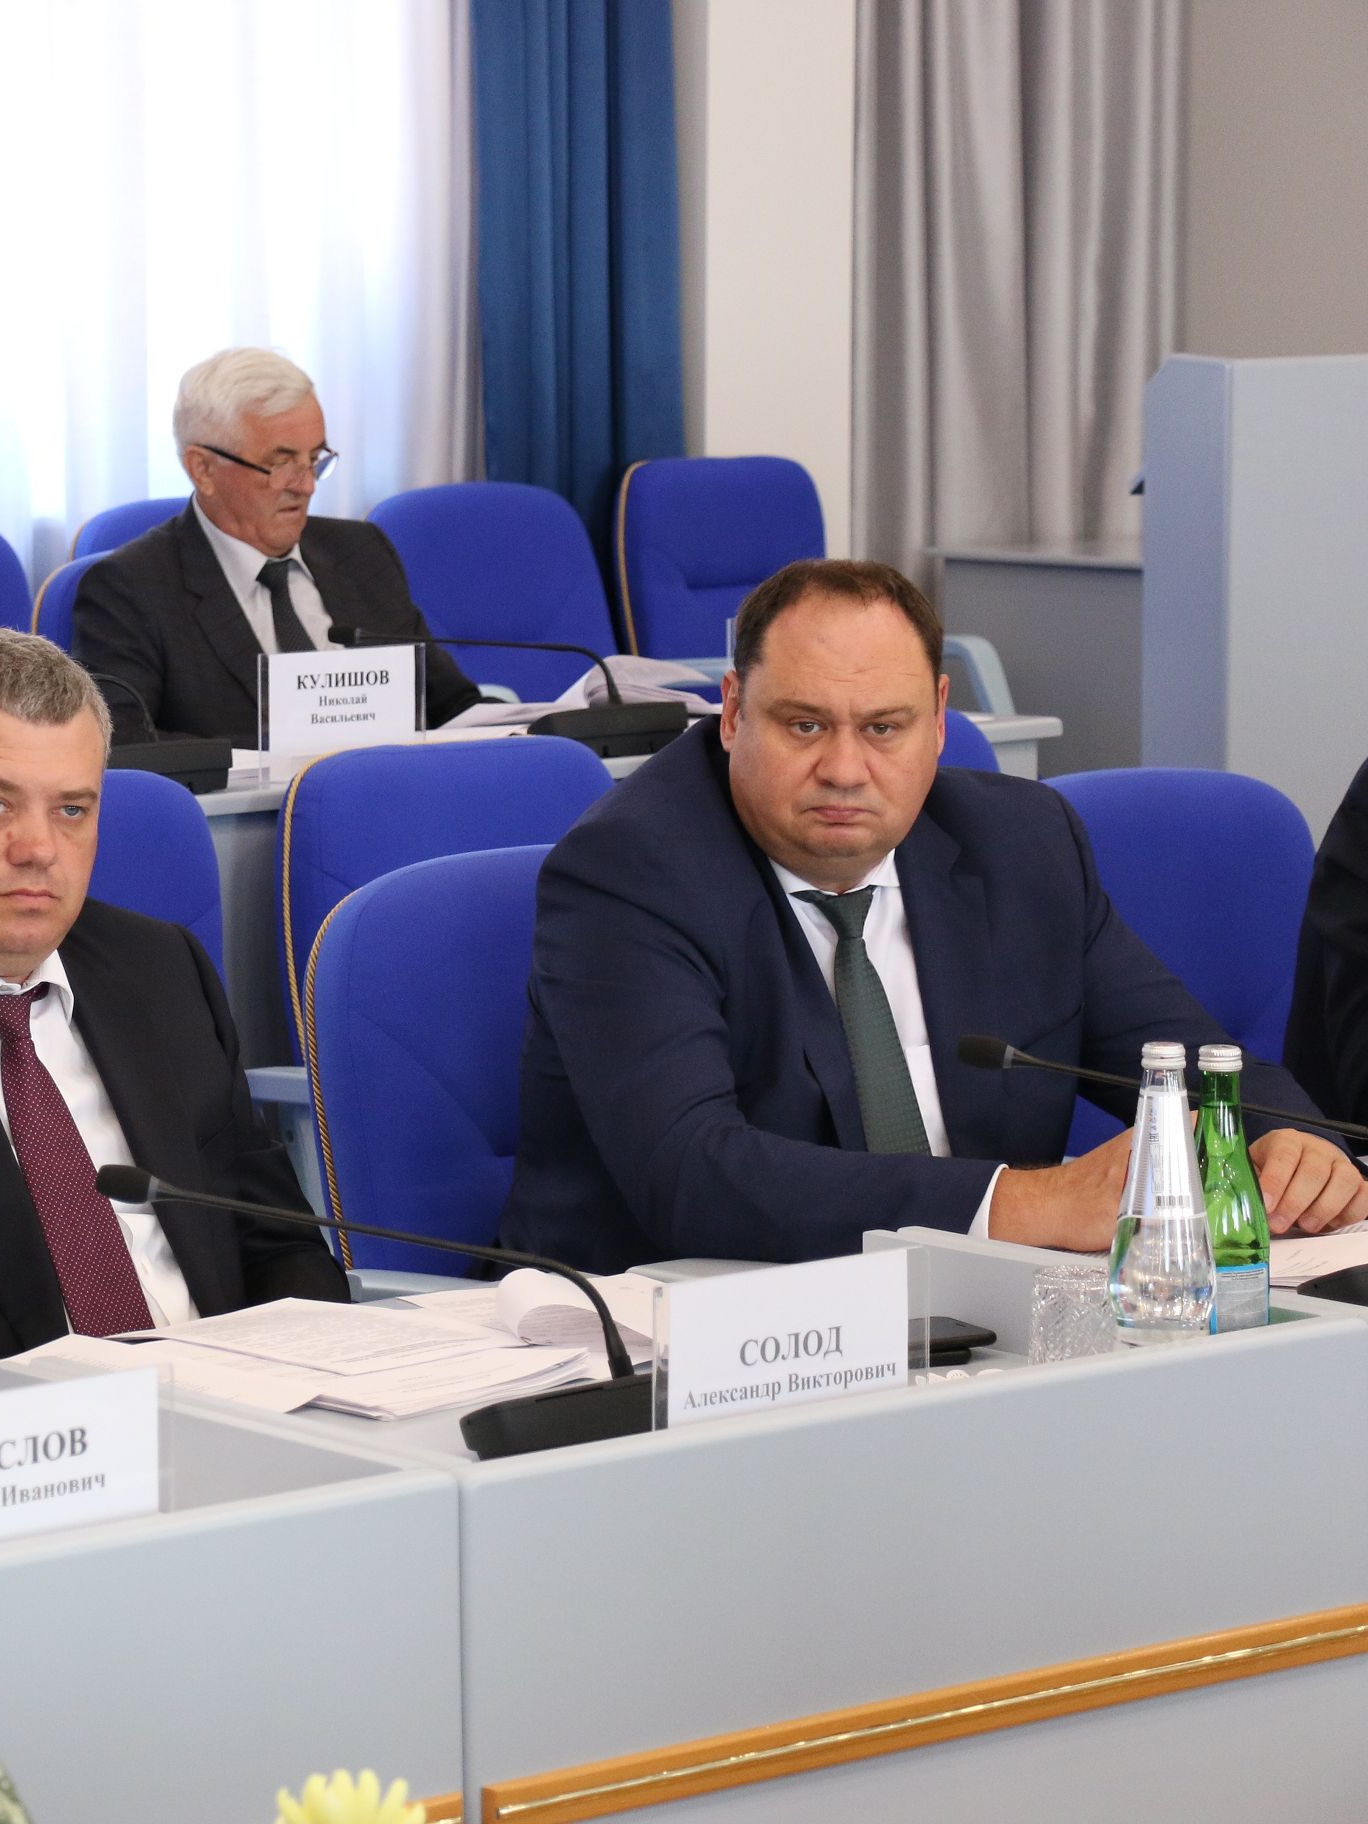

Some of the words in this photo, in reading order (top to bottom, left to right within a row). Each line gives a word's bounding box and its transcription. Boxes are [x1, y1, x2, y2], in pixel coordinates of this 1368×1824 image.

[296, 670, 390, 690] КУЛИШОВ
[319, 694, 368, 707] Николай
[311, 711, 376, 725] Васильевич
[739, 1325, 844, 1367] СОЛОД
[683, 1379, 782, 1410] Александр
[788, 1362, 897, 1393] Викторович
[0, 1473, 107, 1508] Иванович
